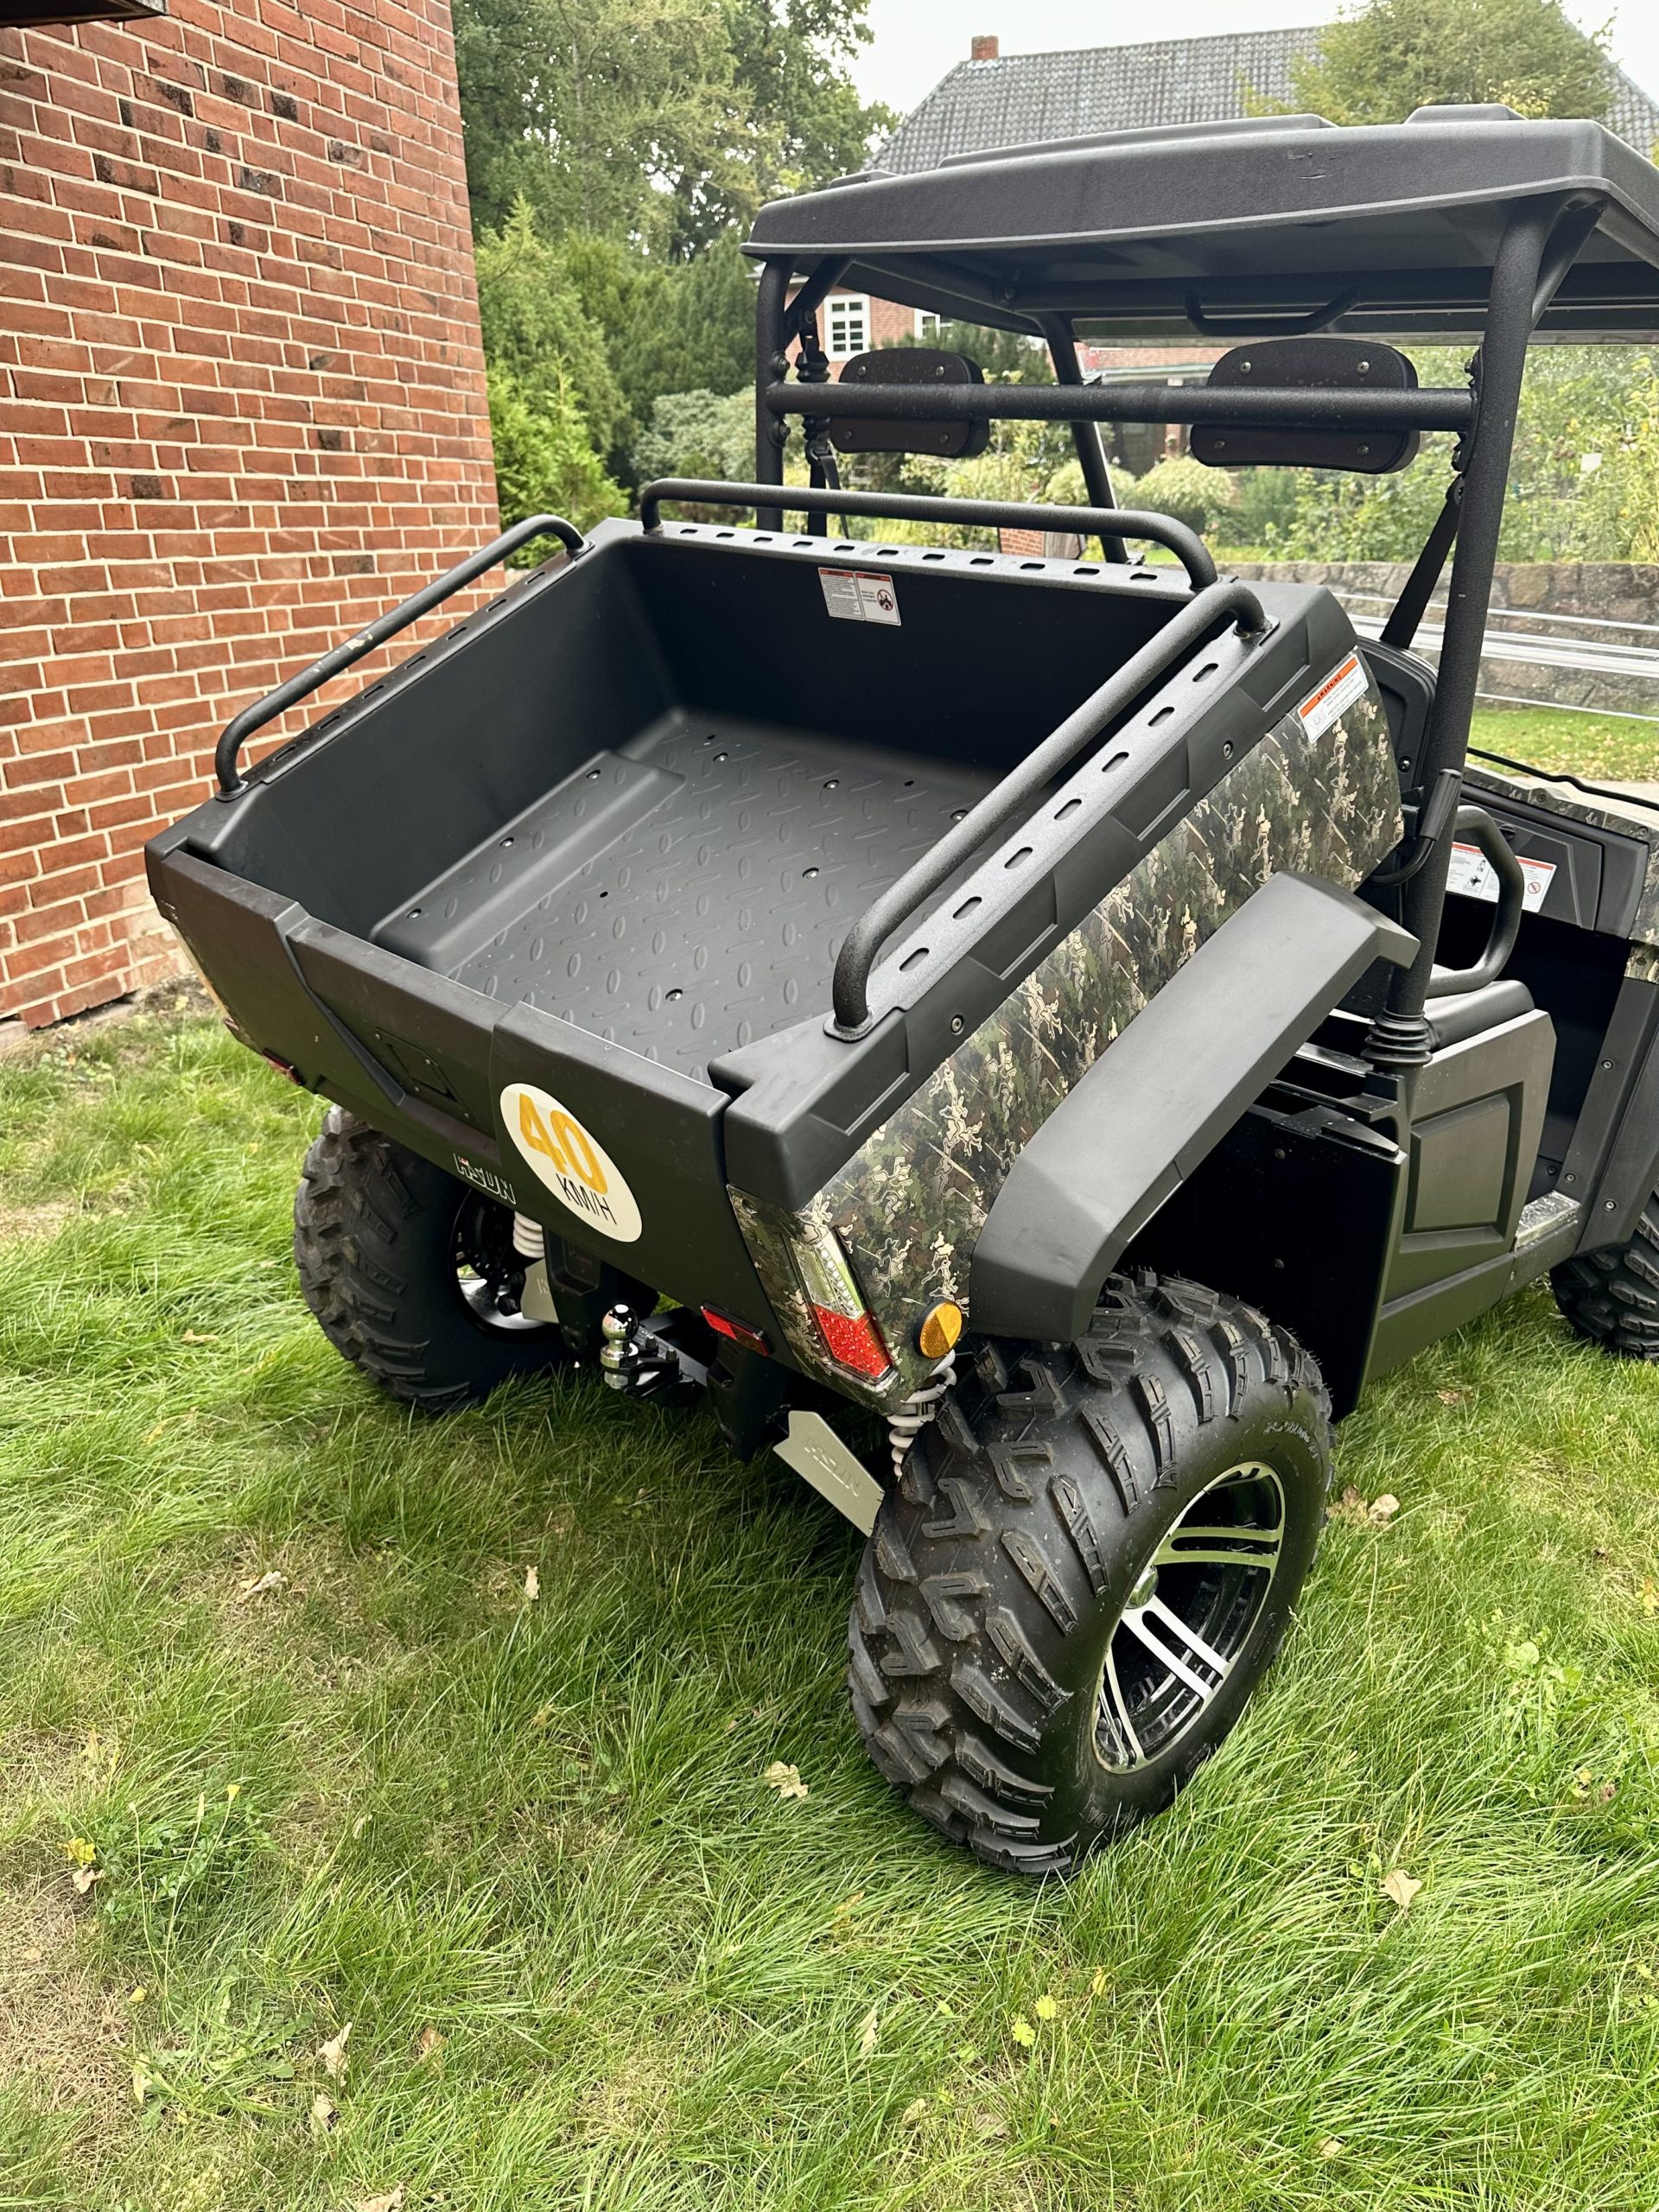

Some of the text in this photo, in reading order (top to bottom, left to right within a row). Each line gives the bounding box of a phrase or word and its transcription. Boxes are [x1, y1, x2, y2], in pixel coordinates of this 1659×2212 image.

[1319, 673, 1342, 697] WARNING
[519, 1092, 607, 1194] 40
[556, 1173, 617, 1224] KM/H
